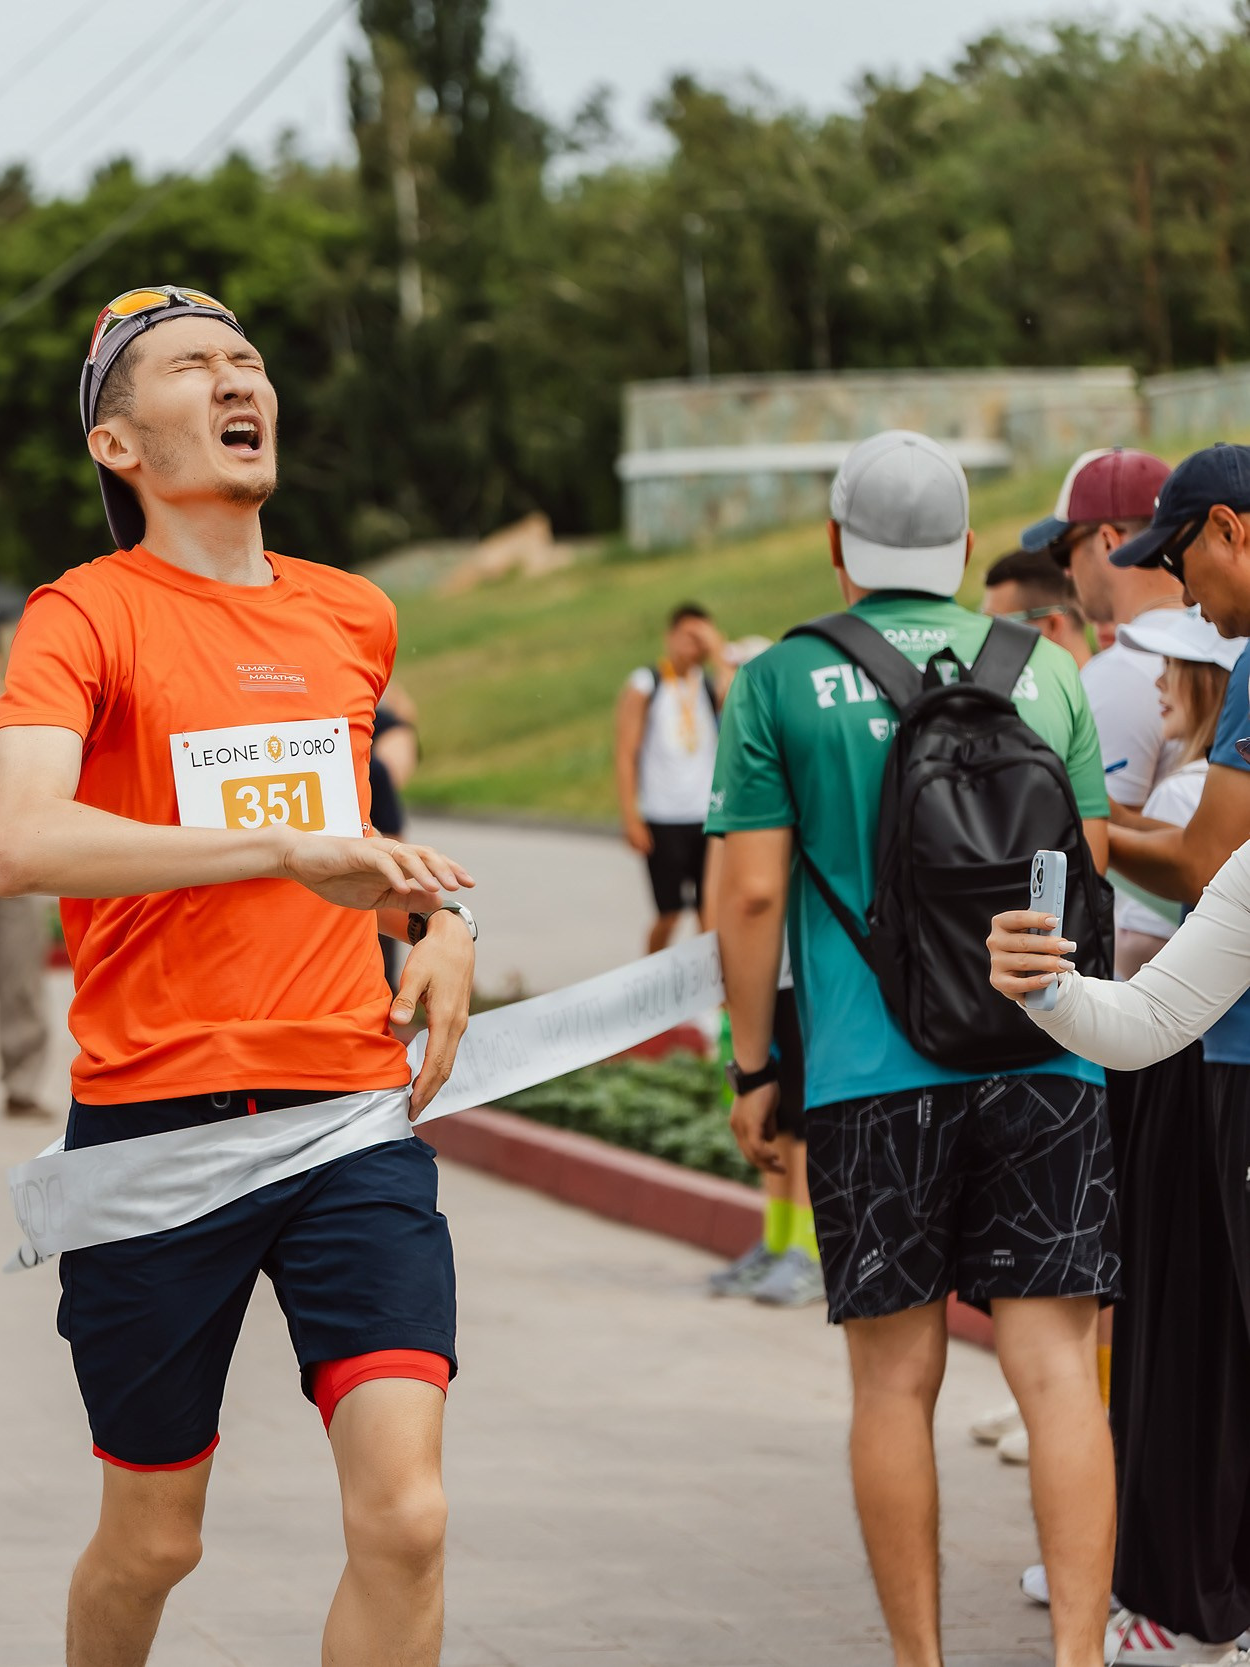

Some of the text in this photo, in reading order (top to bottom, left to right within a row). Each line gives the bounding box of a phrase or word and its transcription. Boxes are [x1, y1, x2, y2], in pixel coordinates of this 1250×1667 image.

[882, 629, 947, 644] QAZAQ
[236, 664, 276, 672] ALMATY
[249, 673, 305, 683] MARATHON
[191, 738, 336, 767] LEONE D'ORO
[235, 780, 311, 829] 351
